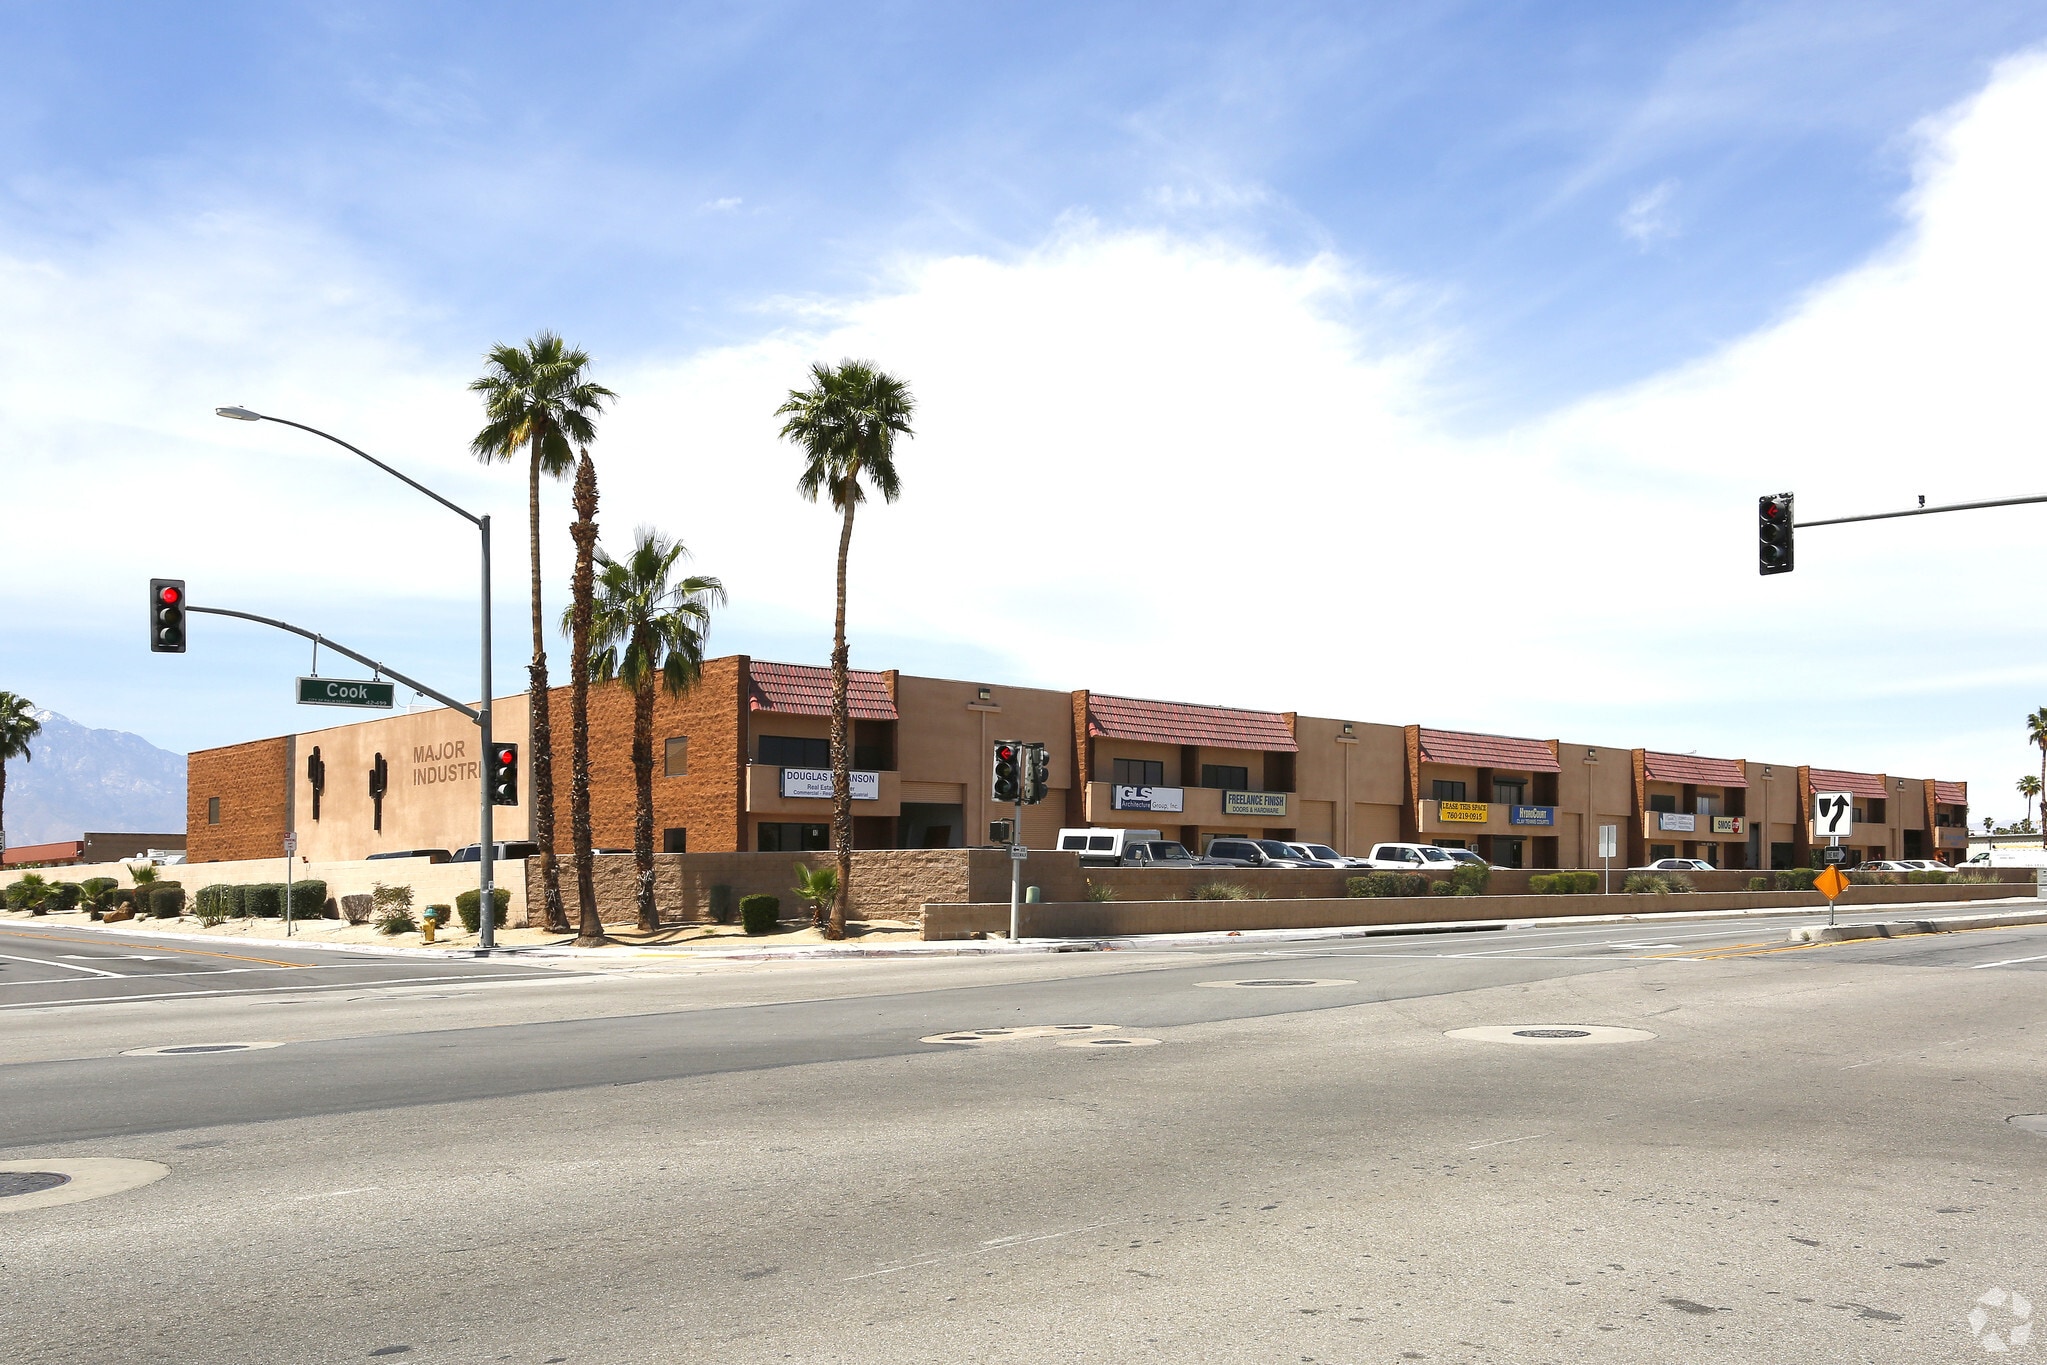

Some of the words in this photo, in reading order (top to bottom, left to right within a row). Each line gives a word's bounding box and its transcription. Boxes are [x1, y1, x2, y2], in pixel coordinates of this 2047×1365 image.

[327, 682, 368, 699] Cook
[413, 740, 465, 763] MAJOR
[413, 761, 481, 786] INDUSTRI
[786, 771, 828, 781] DOUGLAS
[1121, 786, 1152, 801] GLS
[1228, 794, 1263, 805] FREELANCE
[1264, 796, 1284, 806] FINISH
[1152, 802, 1169, 810] Group,
[1718, 820, 1731, 829] SMOG
